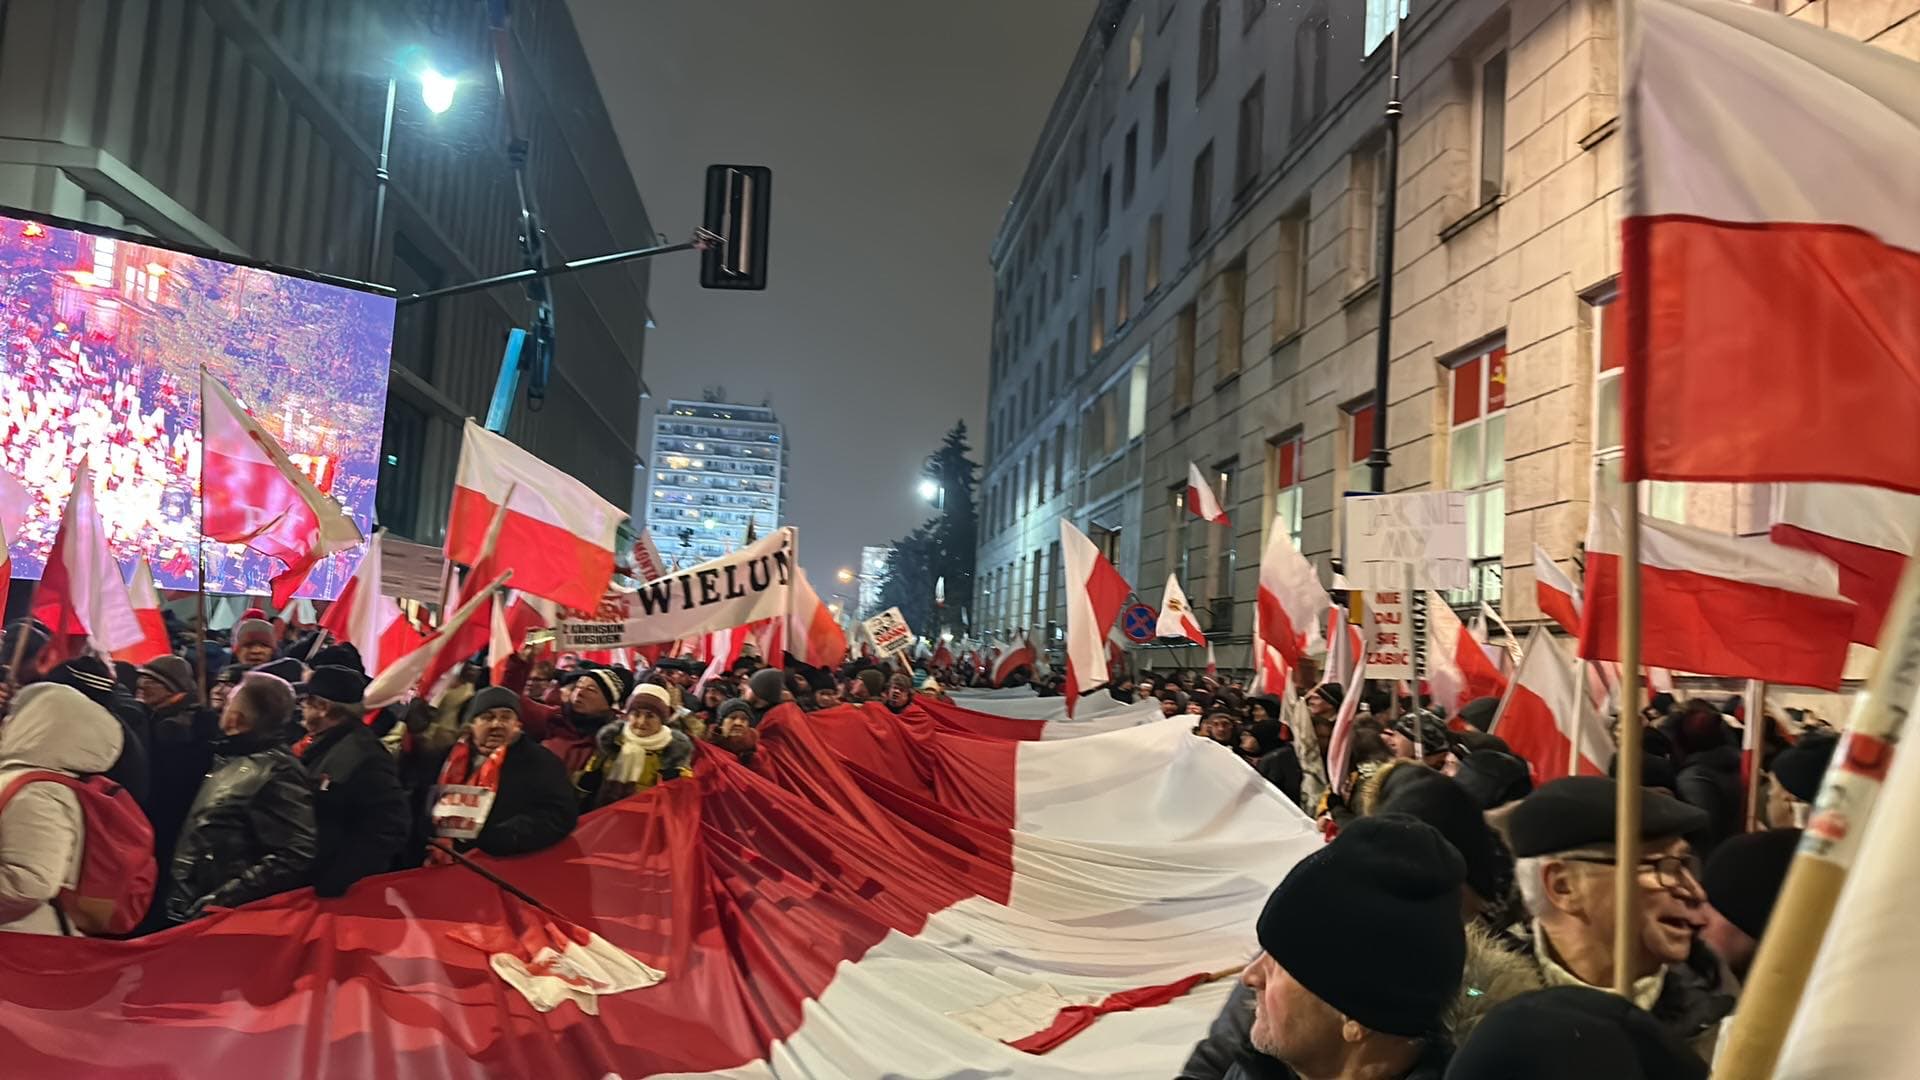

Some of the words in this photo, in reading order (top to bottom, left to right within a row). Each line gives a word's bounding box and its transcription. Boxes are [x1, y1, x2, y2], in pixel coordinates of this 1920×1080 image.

[637, 540, 792, 616] WIELUŃ
[1376, 592, 1401, 604] NIE
[1374, 612, 1402, 625] DAJ
[1376, 632, 1400, 648] SIĘ
[1366, 649, 1409, 666] ZABIĆ
